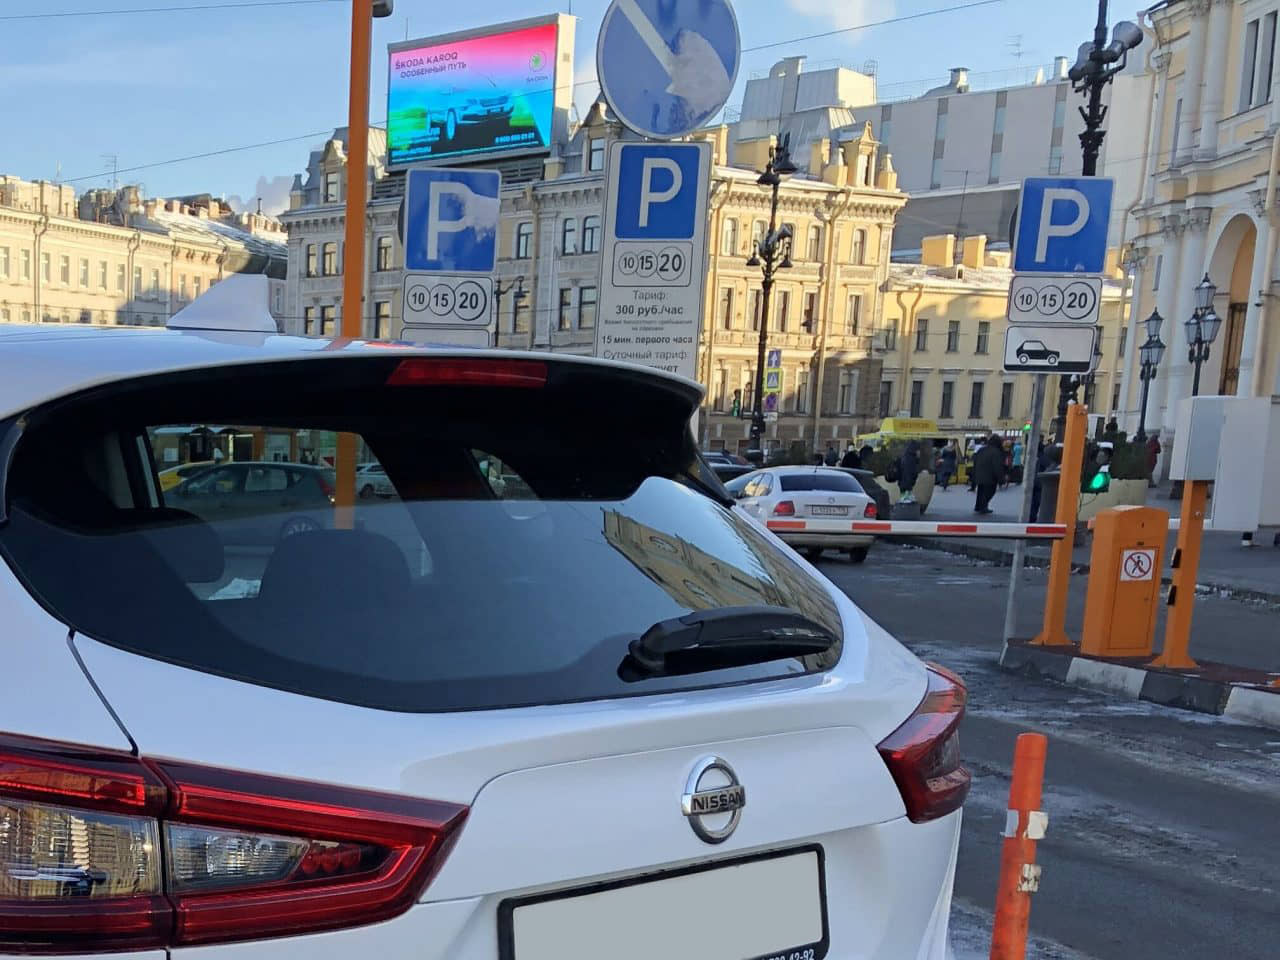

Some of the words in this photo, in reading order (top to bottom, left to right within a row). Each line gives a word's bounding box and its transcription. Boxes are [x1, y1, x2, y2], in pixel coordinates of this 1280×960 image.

[426, 51, 458, 64] KAROQ
[639, 157, 683, 228] P
[426, 181, 472, 261] P
[1034, 188, 1091, 263] P
[623, 256, 635, 269] 10
[639, 255, 653, 270] 15
[659, 253, 683, 272] 20
[412, 292, 425, 304] 10
[433, 293, 449, 308] 15
[458, 292, 479, 310] 20
[632, 290, 669, 302] Тариф:
[1019, 293, 1033, 306] 10
[1041, 293, 1057, 308] 15
[1066, 292, 1088, 309] 20
[615, 305, 635, 315] 300
[637, 304, 684, 317] руб./час
[602, 335, 612, 345] 15
[613, 336, 633, 344] мин.
[635, 336, 671, 347] первого
[673, 335, 693, 344] часа
[603, 349, 653, 361] Суточный
[692, 790, 744, 811] NISSAN
